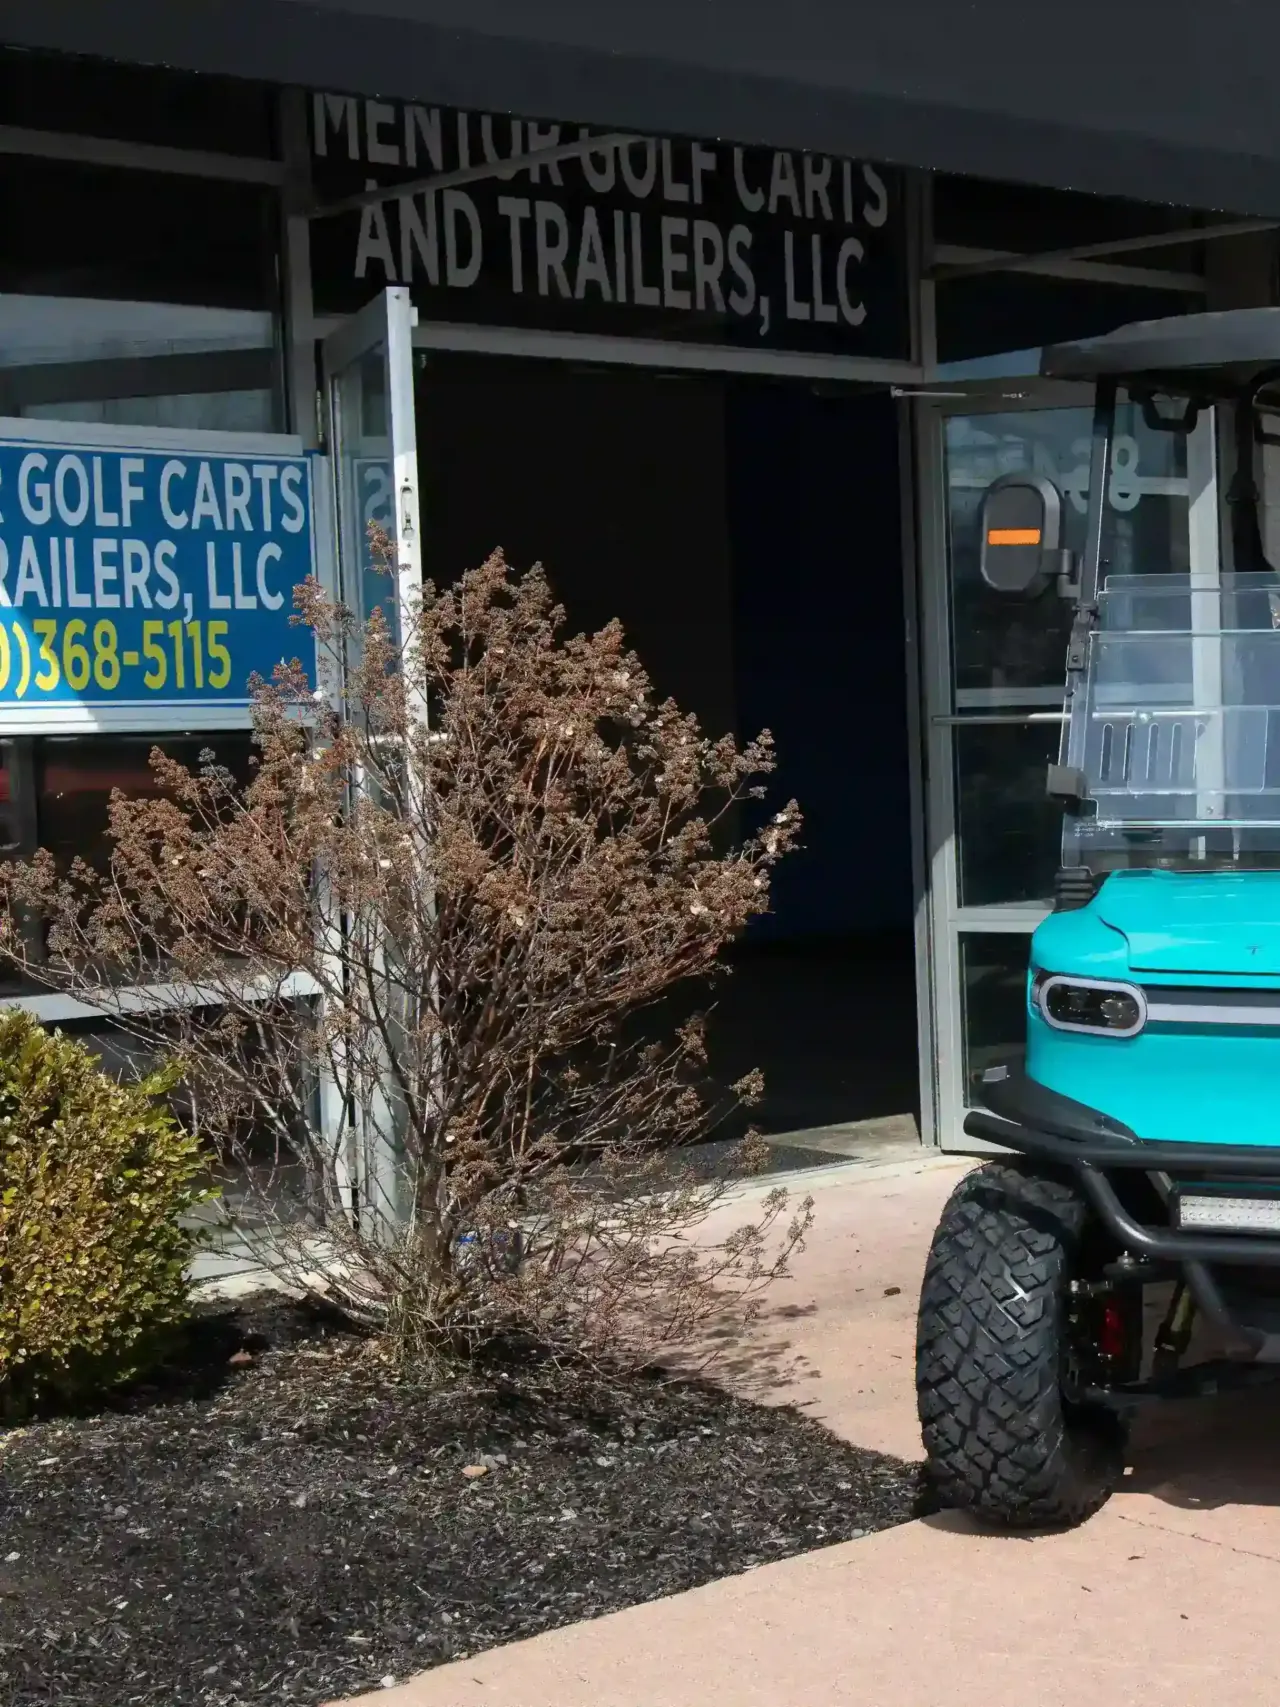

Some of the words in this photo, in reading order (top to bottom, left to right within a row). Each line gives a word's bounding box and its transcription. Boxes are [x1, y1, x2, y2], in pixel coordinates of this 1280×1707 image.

[733, 146, 889, 228] CARTS
[354, 178, 482, 288] AND
[498, 197, 770, 336] TRAILERS,
[784, 229, 868, 327] LLC
[17, 452, 146, 528] GOLF
[159, 459, 306, 534] CARTS
[206, 541, 285, 611] LLC
